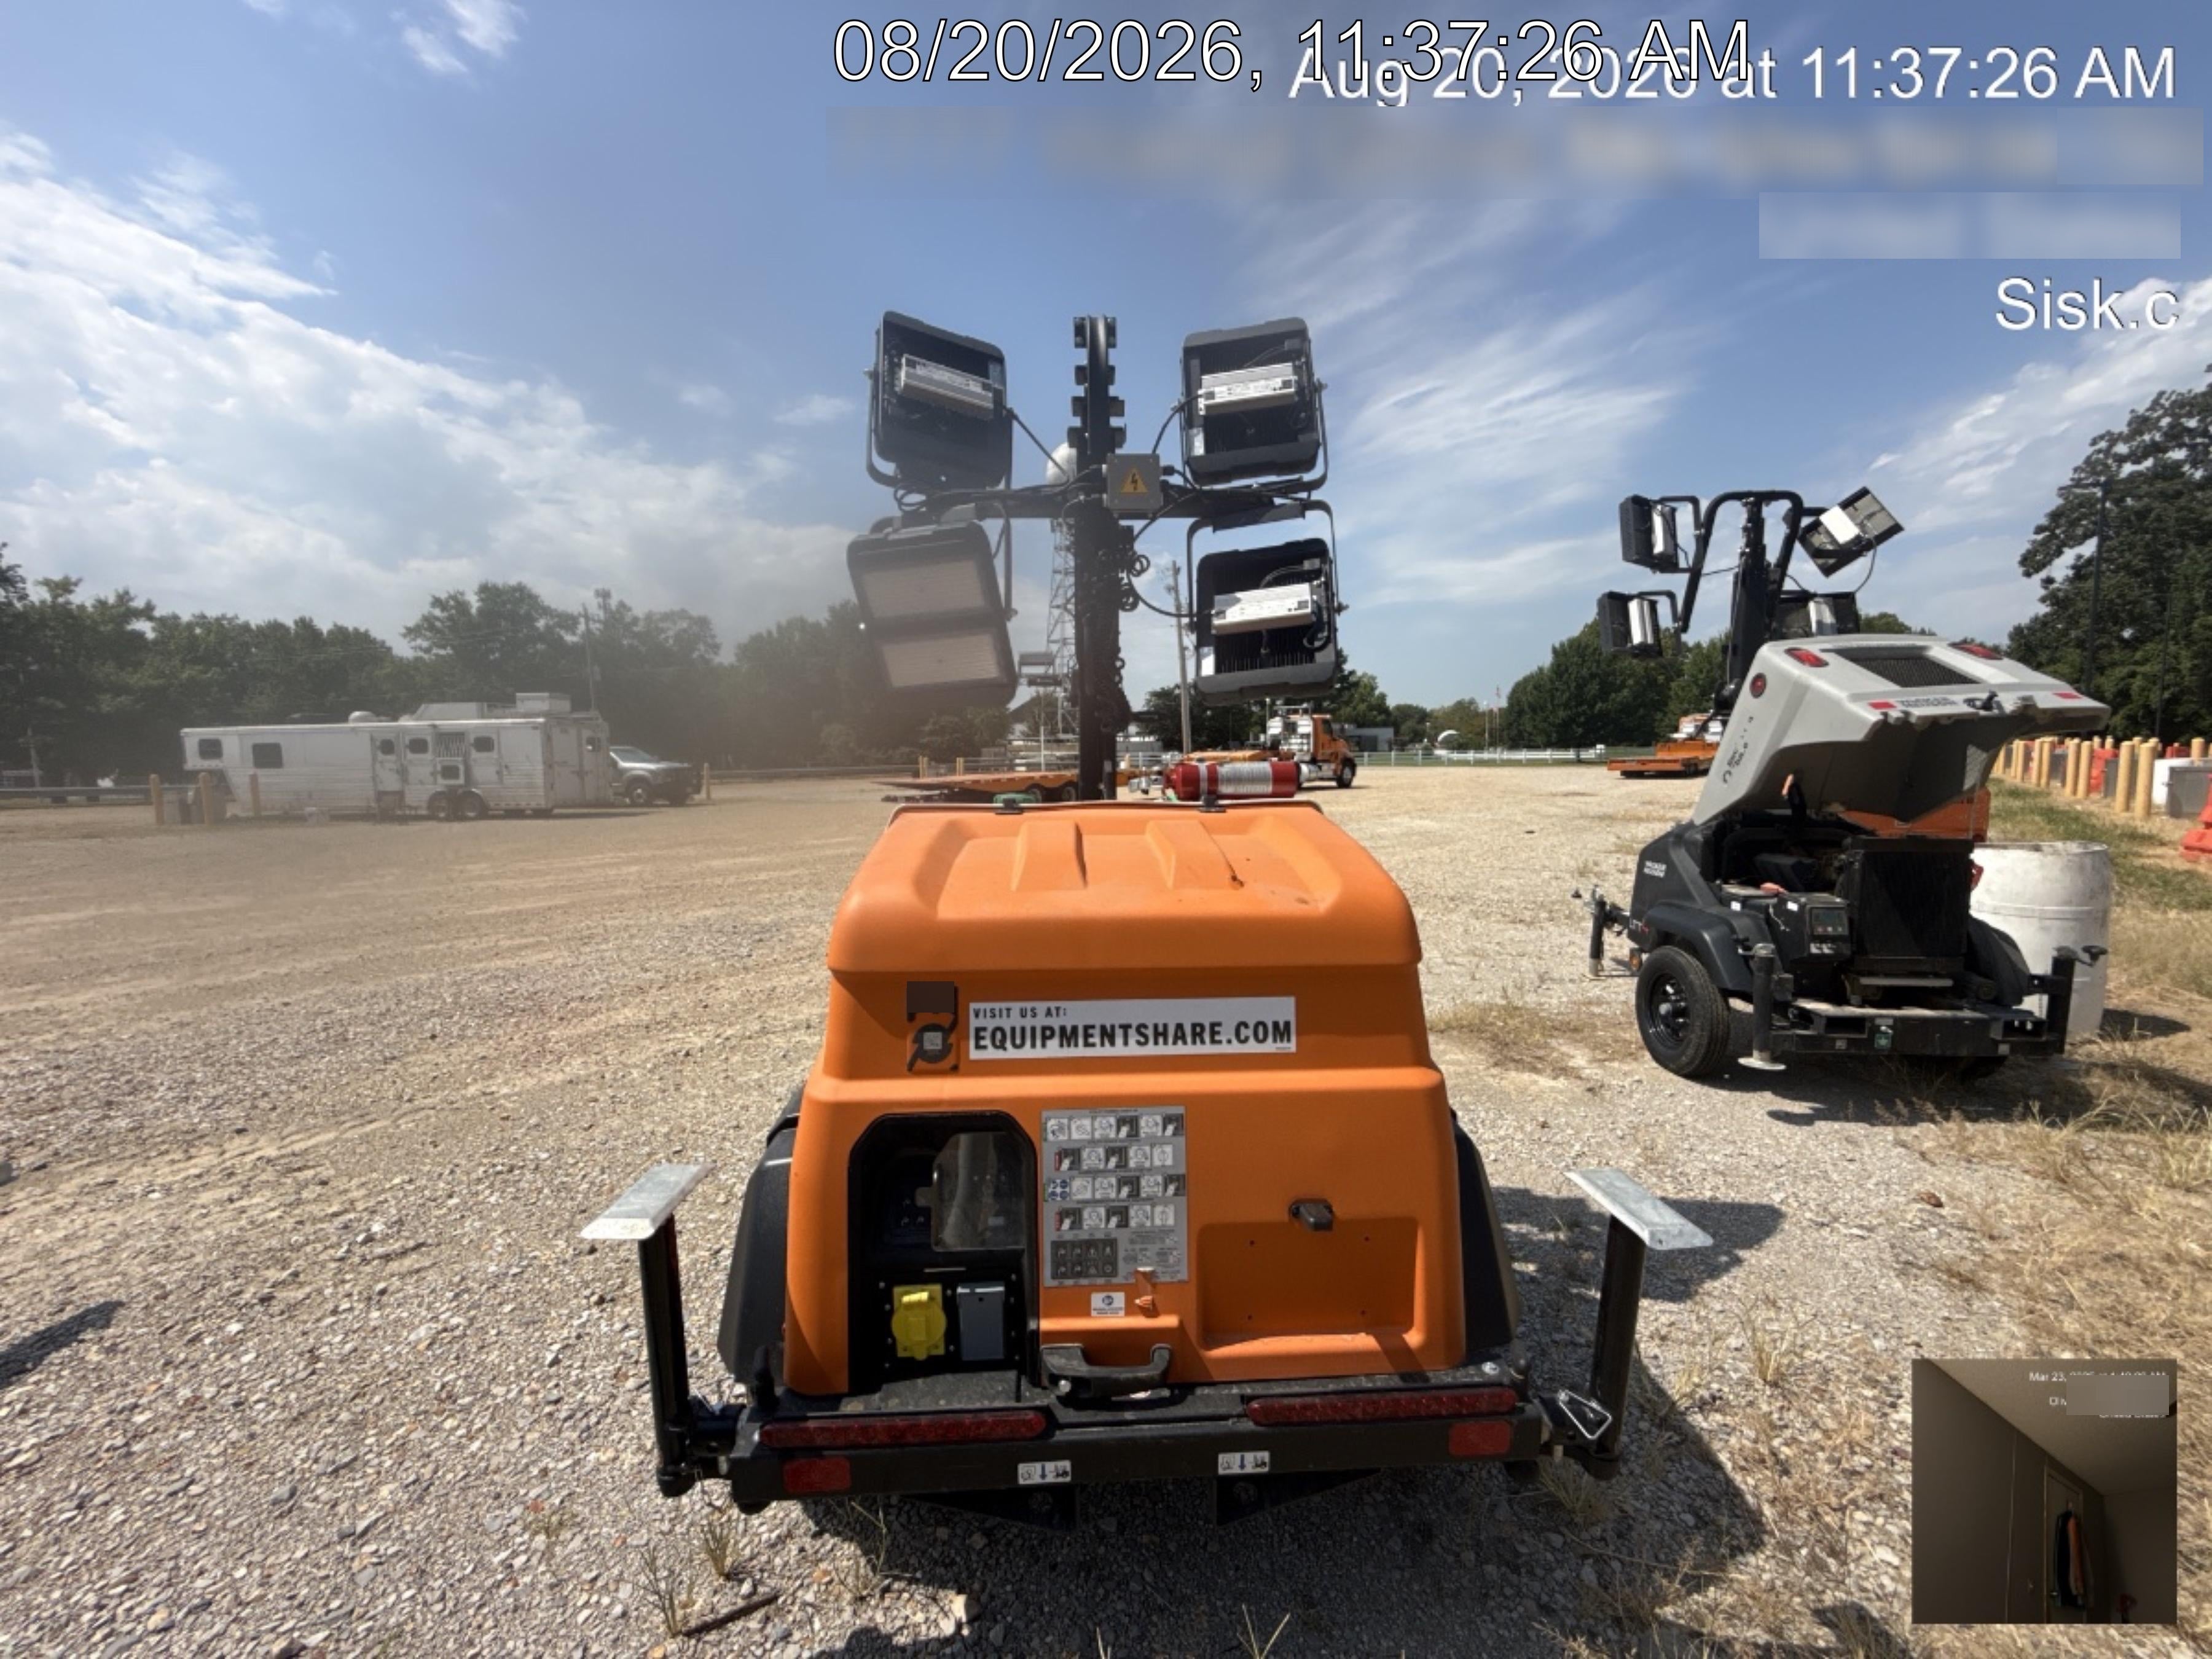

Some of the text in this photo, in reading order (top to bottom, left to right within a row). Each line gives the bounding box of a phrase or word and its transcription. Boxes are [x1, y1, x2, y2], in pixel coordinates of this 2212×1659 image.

[973, 1006, 1067, 1019] VISIT US AT:
[974, 1020, 1292, 1051] EQUIPMENTSHARE.COM
